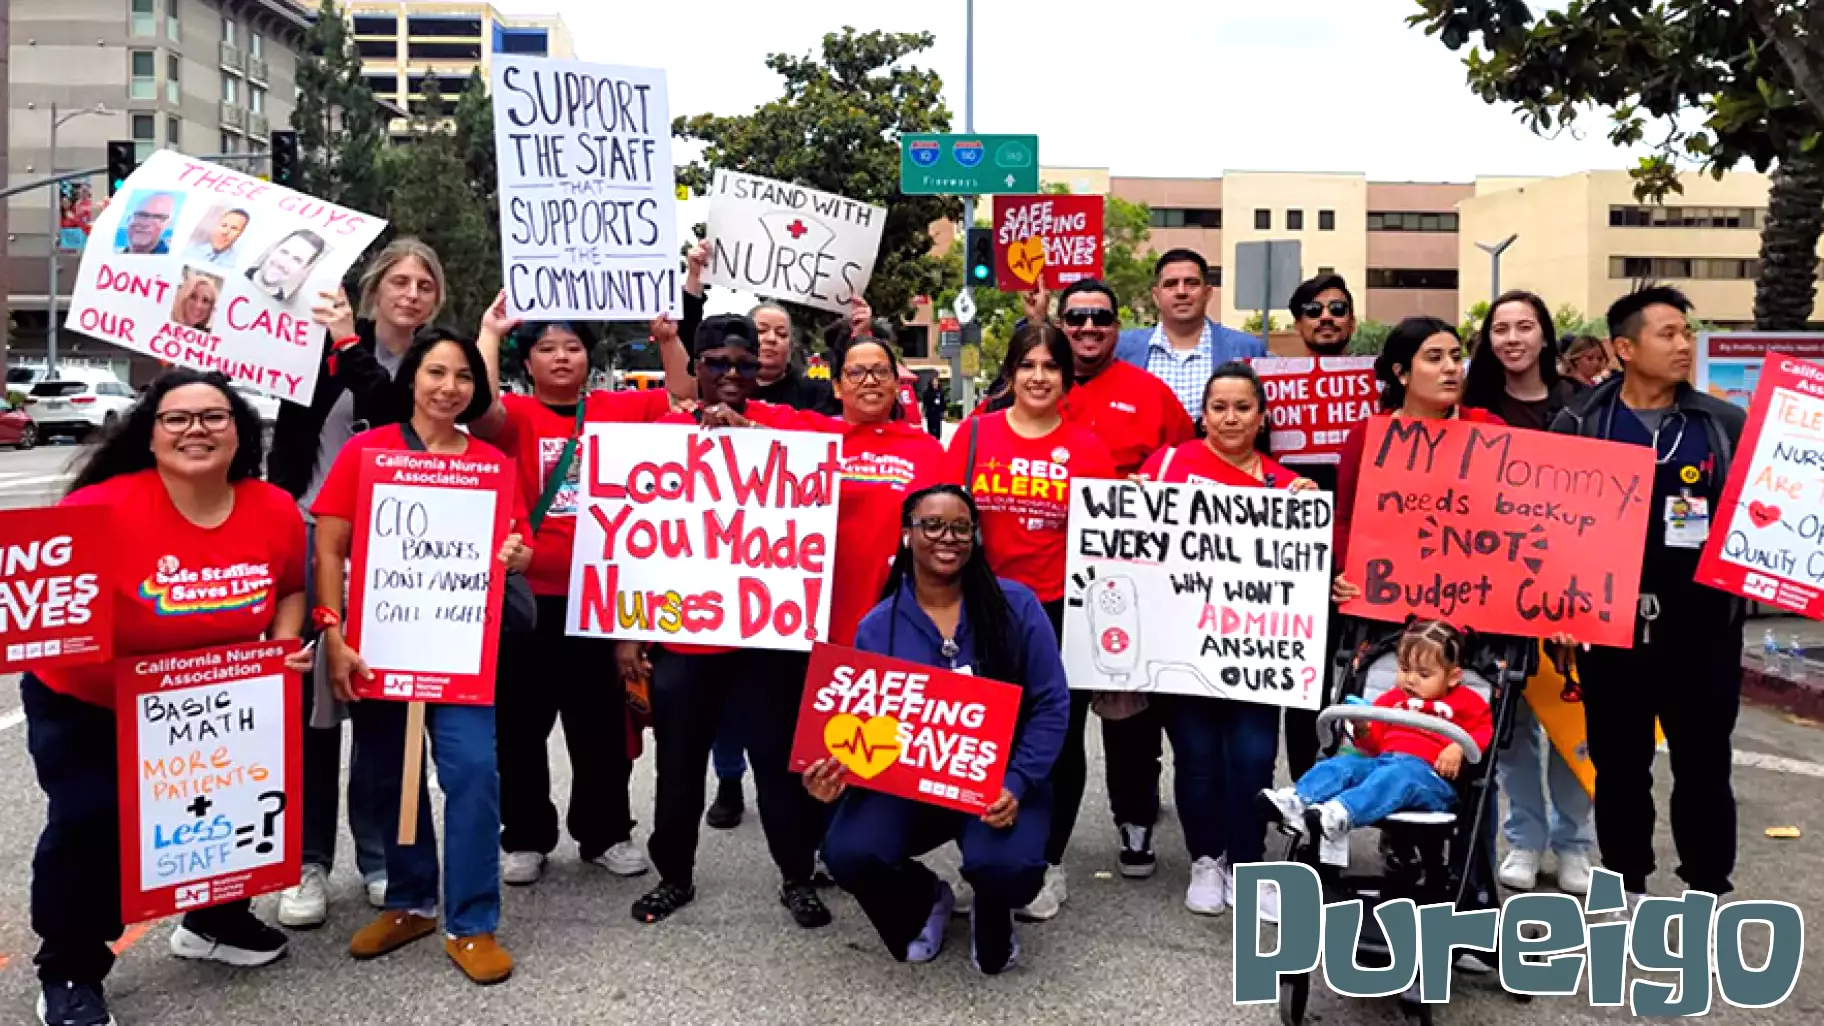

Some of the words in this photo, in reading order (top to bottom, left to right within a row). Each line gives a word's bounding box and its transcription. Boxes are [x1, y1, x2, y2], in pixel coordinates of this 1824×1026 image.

[503, 66, 651, 134] SUPPORT
[508, 133, 567, 177] THE
[576, 132, 655, 182] STAFF
[175, 162, 270, 204] THESE
[278, 194, 366, 237] GUYS
[559, 181, 605, 197] THAT
[719, 175, 729, 195] I
[734, 177, 808, 210] STAND
[812, 199, 873, 228] WITH
[511, 196, 659, 246] SUPPORTS
[999, 213, 1086, 245] STAFFING
[1003, 200, 1054, 230] SAFE
[564, 247, 600, 265] THE
[1041, 235, 1096, 254] SAVES
[1043, 248, 1094, 267] LIVES
[509, 263, 675, 312] COMMUNITY!
[709, 236, 863, 307] NURSES
[96, 264, 170, 304] DON'T
[226, 296, 311, 348] CARE
[79, 307, 136, 343] OUR
[149, 336, 304, 397] COMMUNITY
[157, 322, 222, 352] ABOUT
[1263, 378, 1310, 402] OME
[1315, 374, 1371, 398] CUTS
[1268, 403, 1319, 427] ON'T
[375, 454, 446, 471] California
[449, 458, 500, 474] Nurses
[1373, 419, 1446, 473] MY
[393, 469, 480, 486] Association
[588, 433, 721, 503] Look
[719, 435, 840, 508] What
[972, 473, 1068, 501] ALERT
[1010, 457, 1068, 480] RED
[1189, 489, 1331, 530] ANSWERED
[1377, 488, 1470, 515] needs
[1495, 491, 1596, 537] backup
[588, 504, 693, 560] You
[703, 508, 826, 573] Made
[1079, 528, 1170, 563] EVERY
[1181, 531, 1242, 564] CALL
[1255, 538, 1329, 571] LIGHT
[1441, 526, 1527, 562] NOT
[1725, 530, 1797, 577] QUALITY
[201, 563, 269, 581] Staffing
[1169, 571, 1214, 603] WHY
[1224, 580, 1295, 606] WON'T
[1365, 558, 1493, 617] Budget
[1515, 571, 1614, 624] Cuts!
[171, 585, 228, 601] Saves
[579, 563, 725, 634] Nurses
[738, 575, 823, 640] Do!
[135, 653, 222, 675] California
[226, 646, 284, 661] Nurses
[1200, 634, 1306, 661] ANSWER
[160, 662, 261, 688] Association
[830, 664, 930, 703] SAFE
[143, 690, 232, 723] BASIC
[169, 706, 254, 745] MATH
[813, 685, 988, 728] STAFFING
[893, 720, 998, 767] SAVES
[898, 742, 988, 782] LIVES
[153, 761, 270, 801] PATIENTS
[156, 841, 233, 878] STAFF
